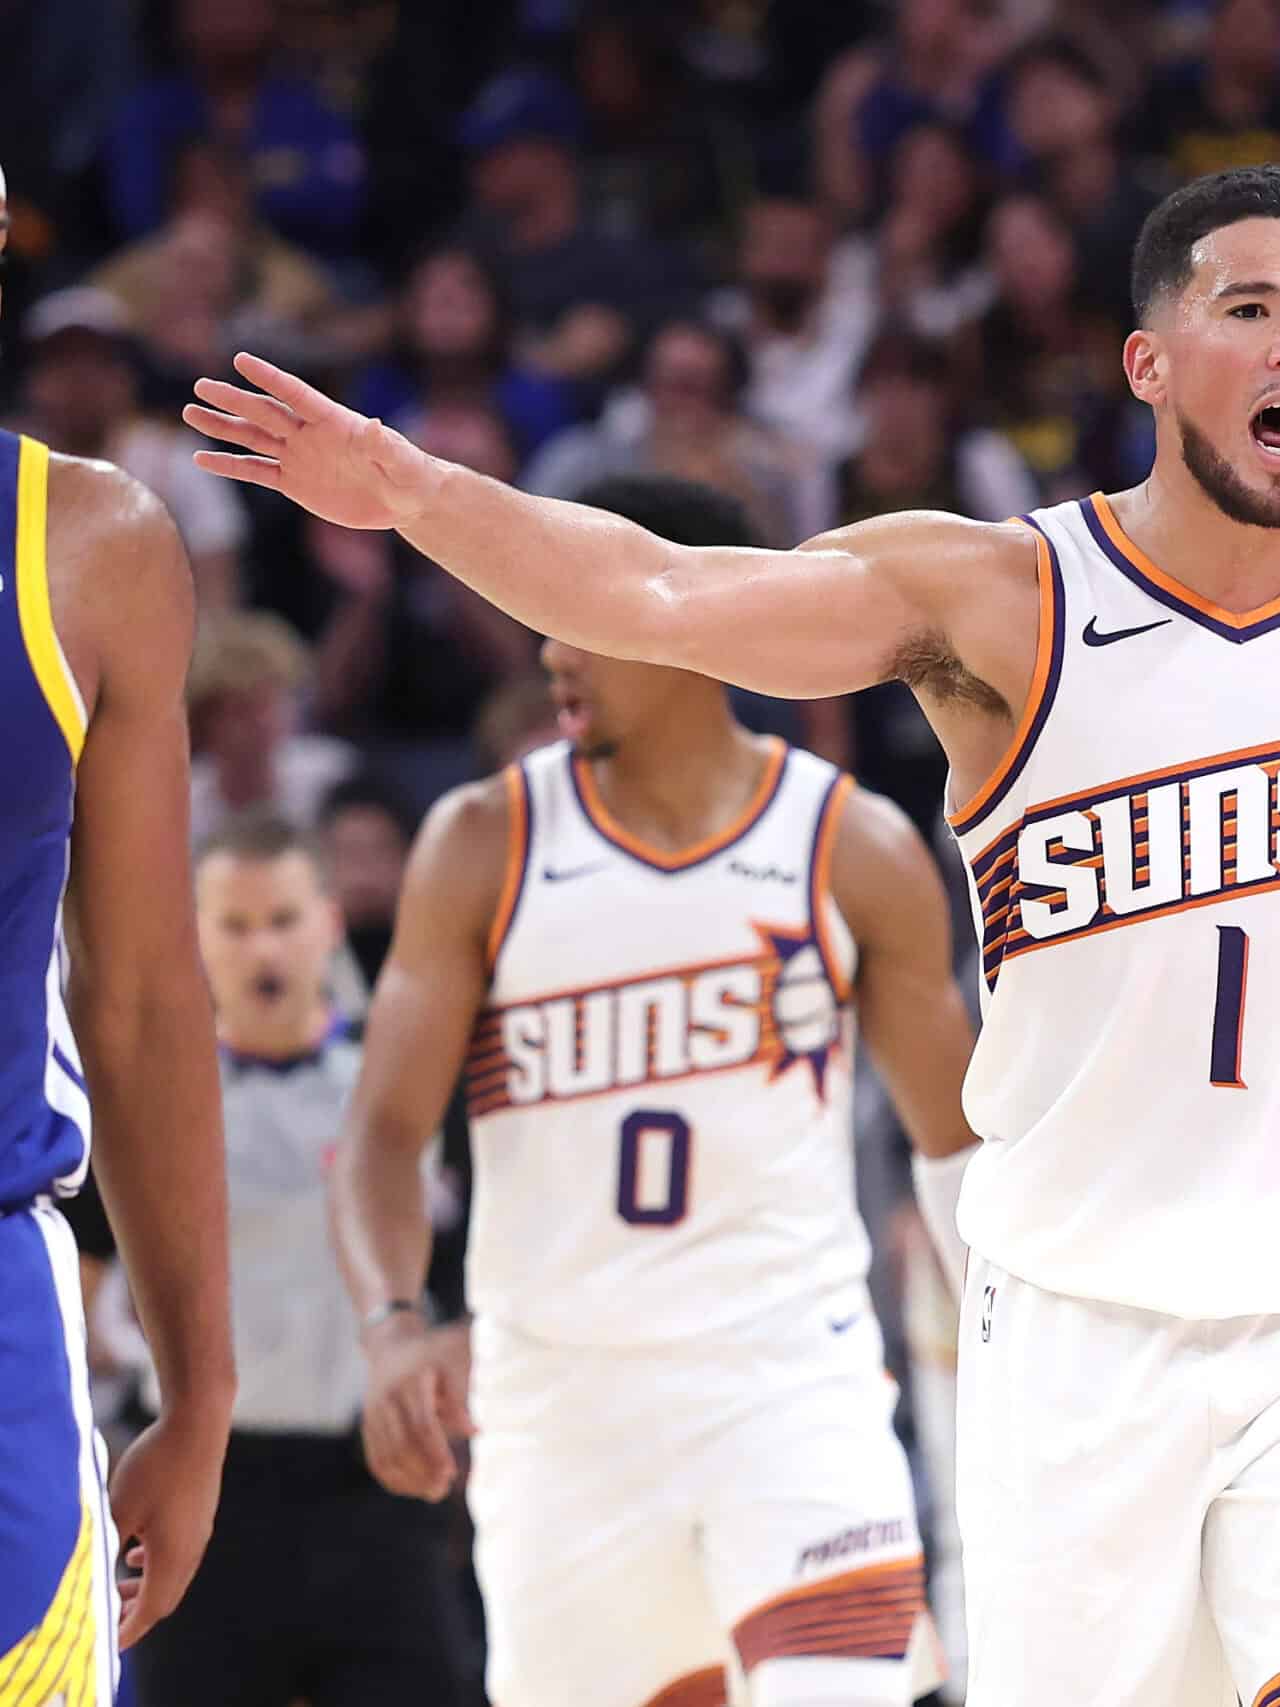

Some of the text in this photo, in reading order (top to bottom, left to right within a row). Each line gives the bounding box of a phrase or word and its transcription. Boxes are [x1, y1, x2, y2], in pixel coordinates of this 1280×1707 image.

[504, 964, 761, 1103] SUNS
[1210, 925, 1249, 1089] 1
[616, 1109, 692, 1227] 0
